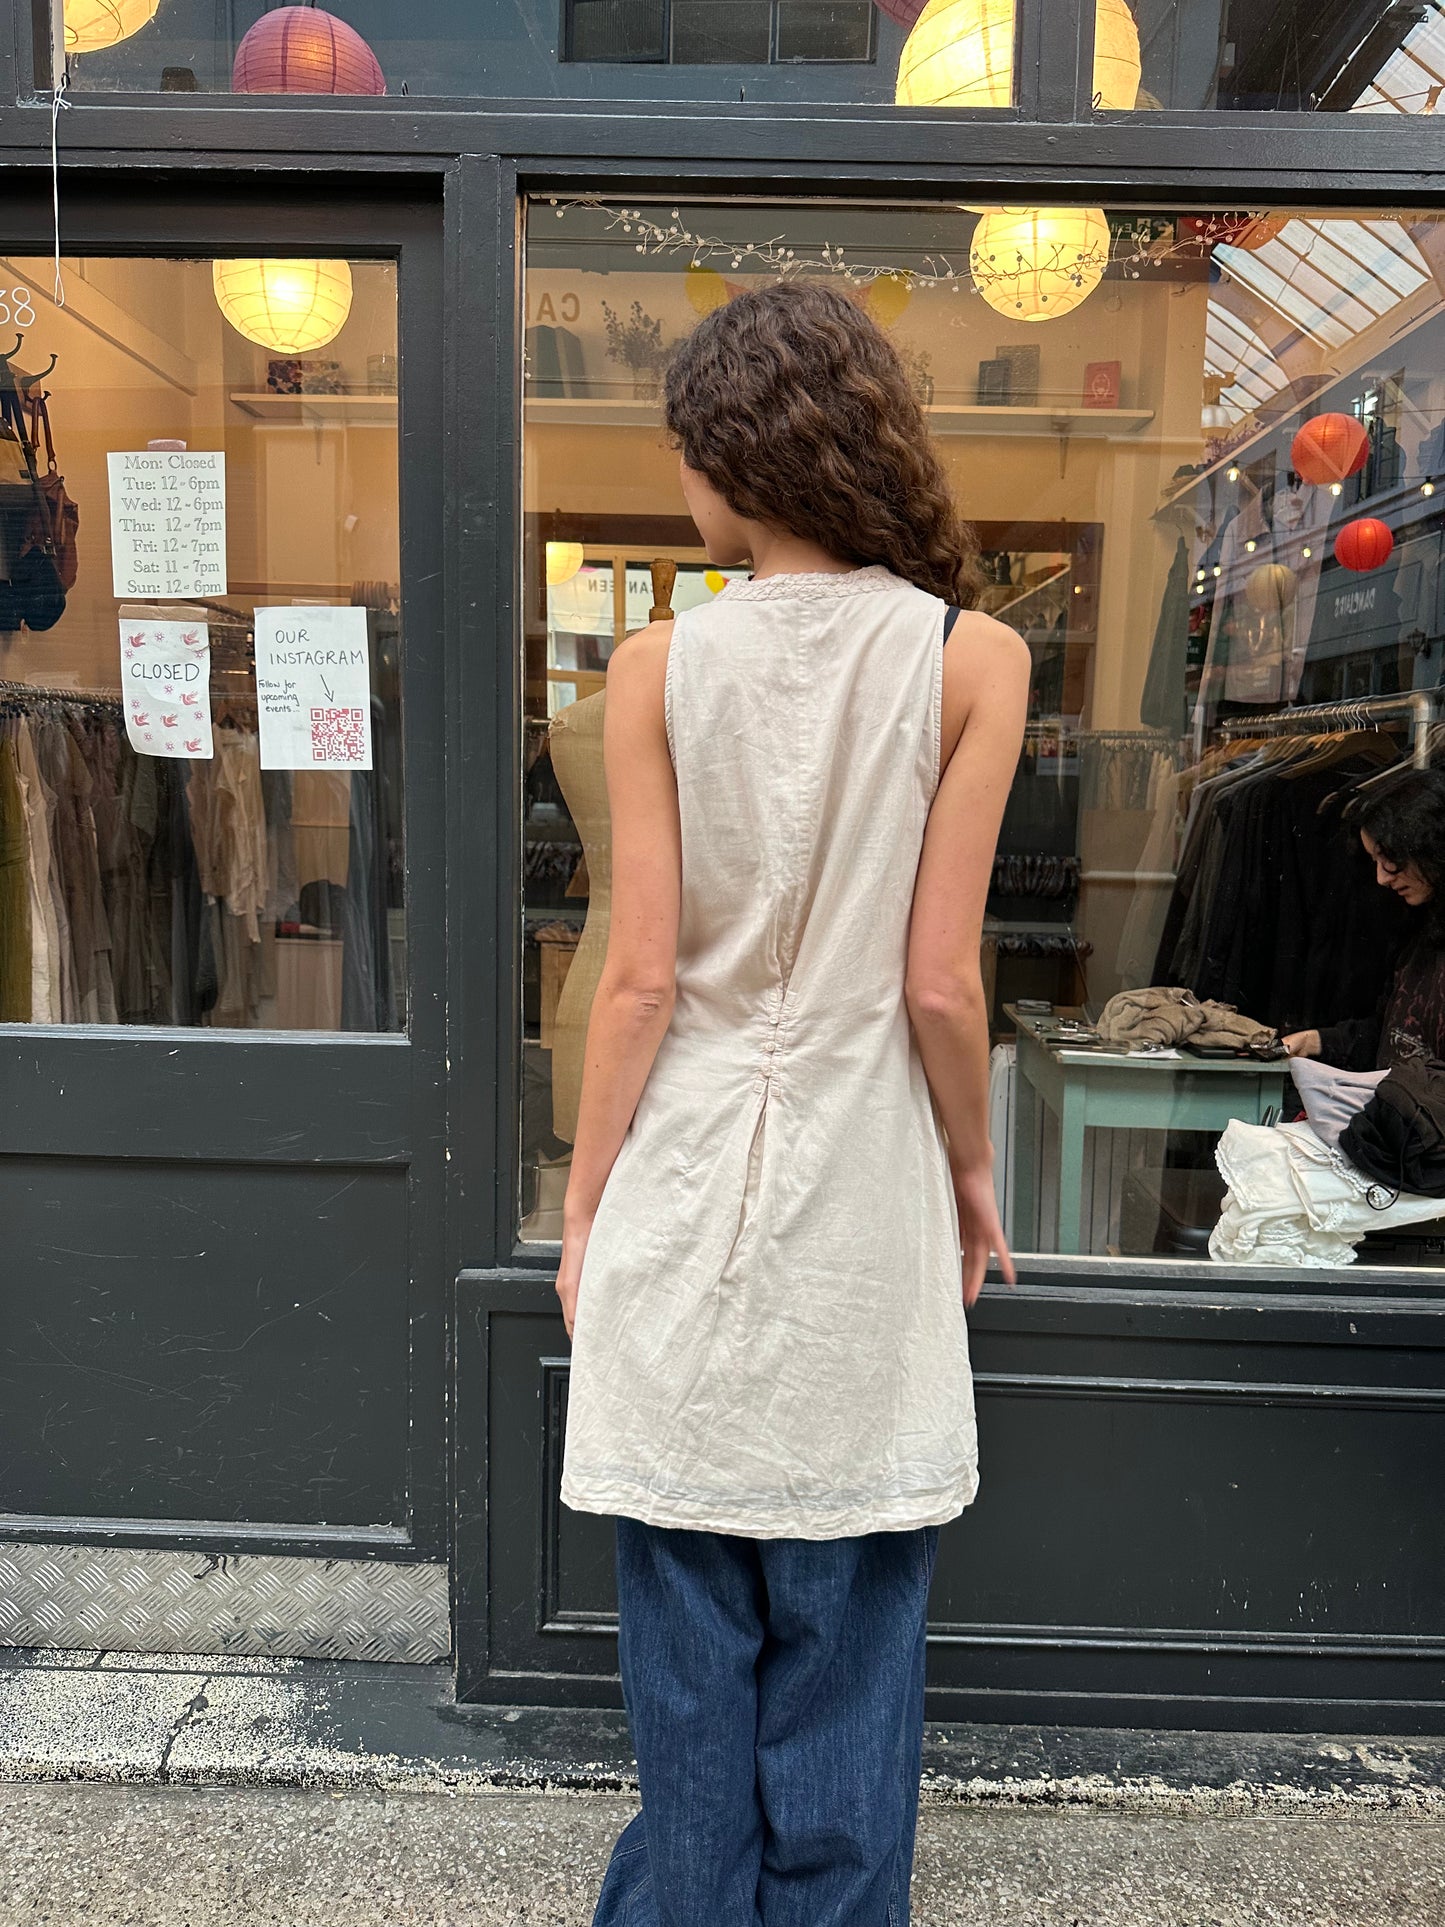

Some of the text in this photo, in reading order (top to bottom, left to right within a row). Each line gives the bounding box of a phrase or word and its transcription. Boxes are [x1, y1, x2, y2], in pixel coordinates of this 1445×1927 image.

[124, 454, 216, 469] Mon: Closed
[122, 476, 156, 490] Tue:
[120, 497, 161, 511] Wed:
[118, 518, 155, 532] Thu:
[132, 539, 158, 552] Fri:
[133, 559, 160, 573] Sat:
[127, 579, 160, 593] Sun:
[275, 628, 310, 643] OUR
[270, 650, 364, 665] INSTAGRAM
[131, 662, 200, 682] CLOSED
[258, 679, 297, 694] Follow for
[260, 693, 300, 707] upcoming
